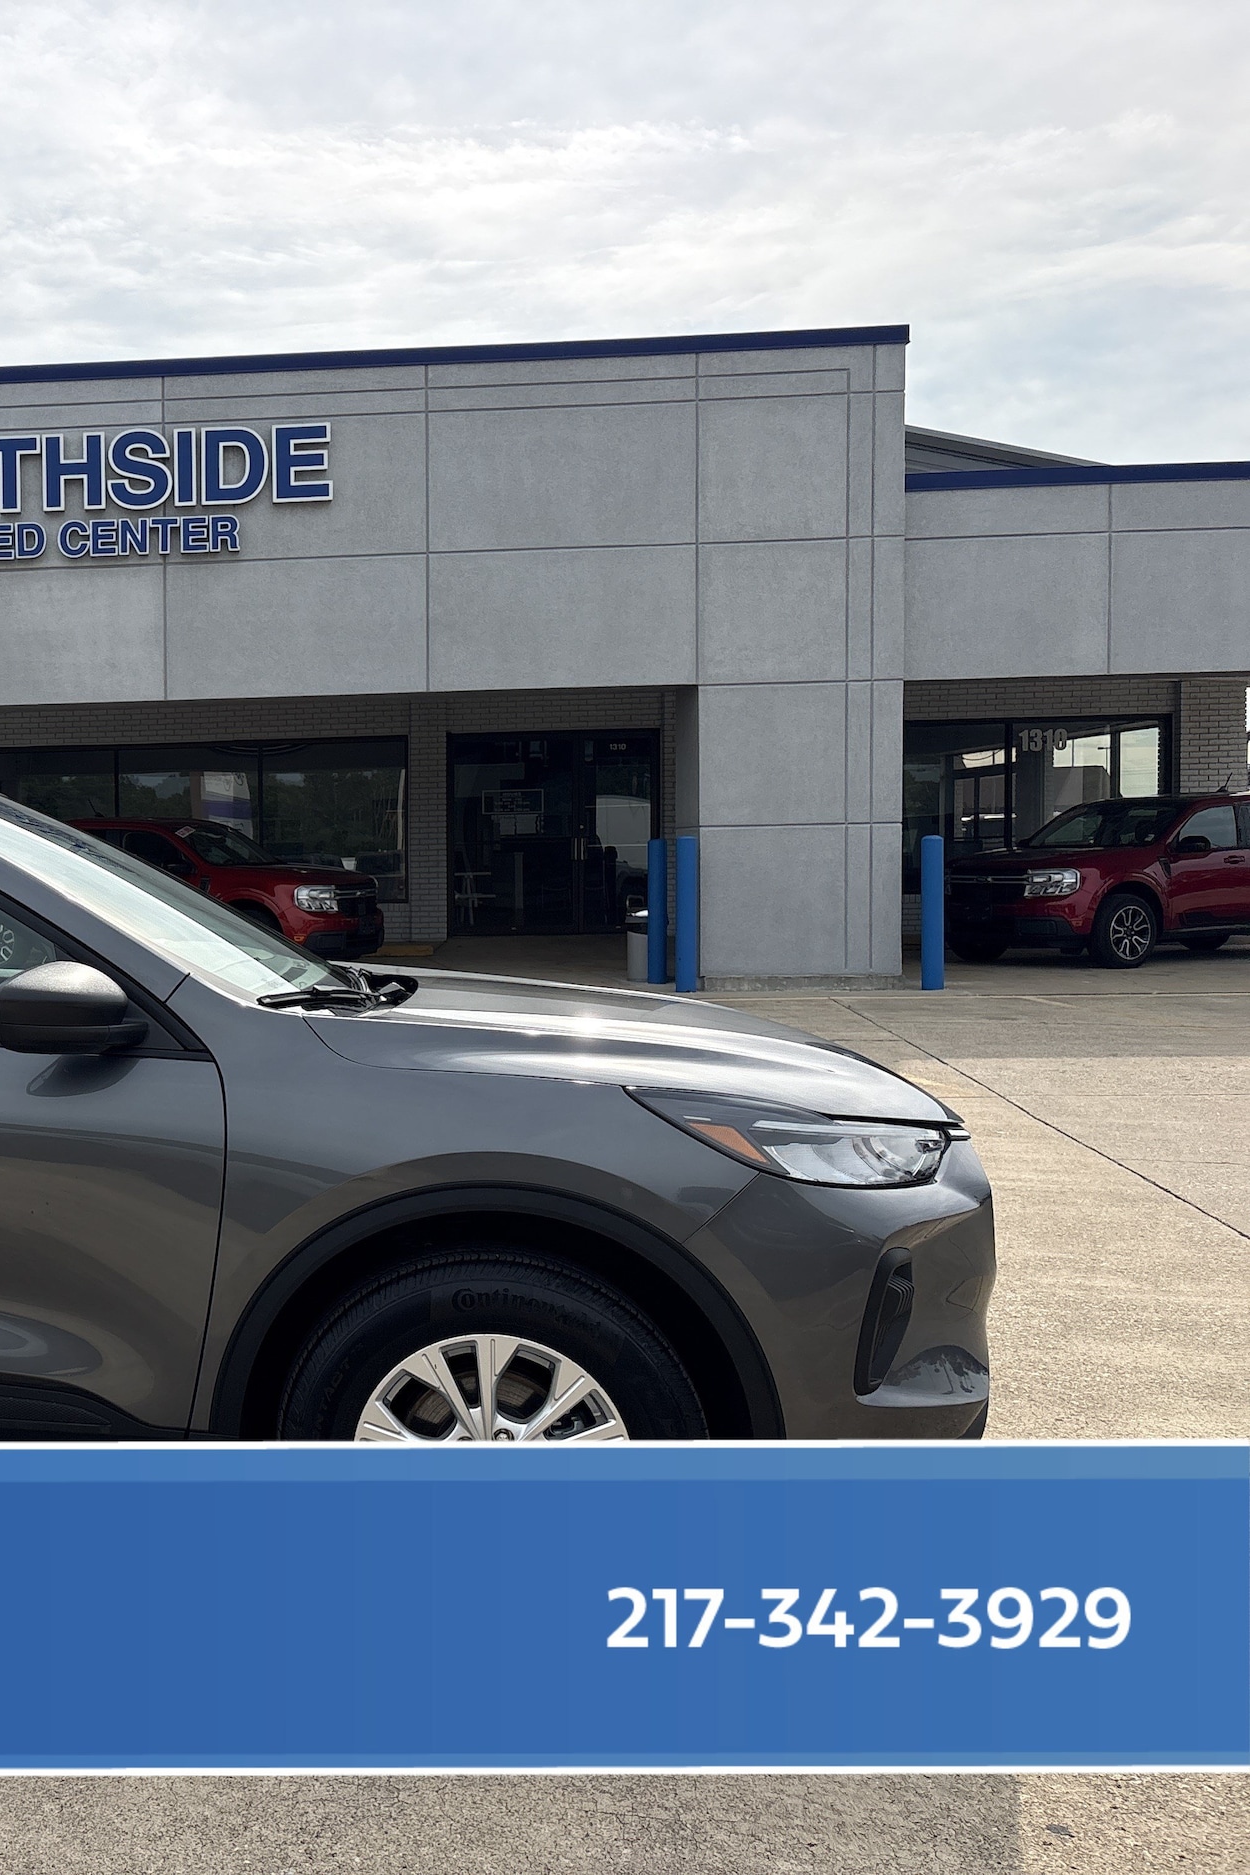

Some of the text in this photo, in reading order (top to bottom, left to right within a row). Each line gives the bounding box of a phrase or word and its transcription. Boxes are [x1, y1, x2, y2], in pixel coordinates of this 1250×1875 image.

[58, 515, 241, 560] CENTER
[609, 743, 627, 751] 1310
[1018, 728, 1068, 752] 1310
